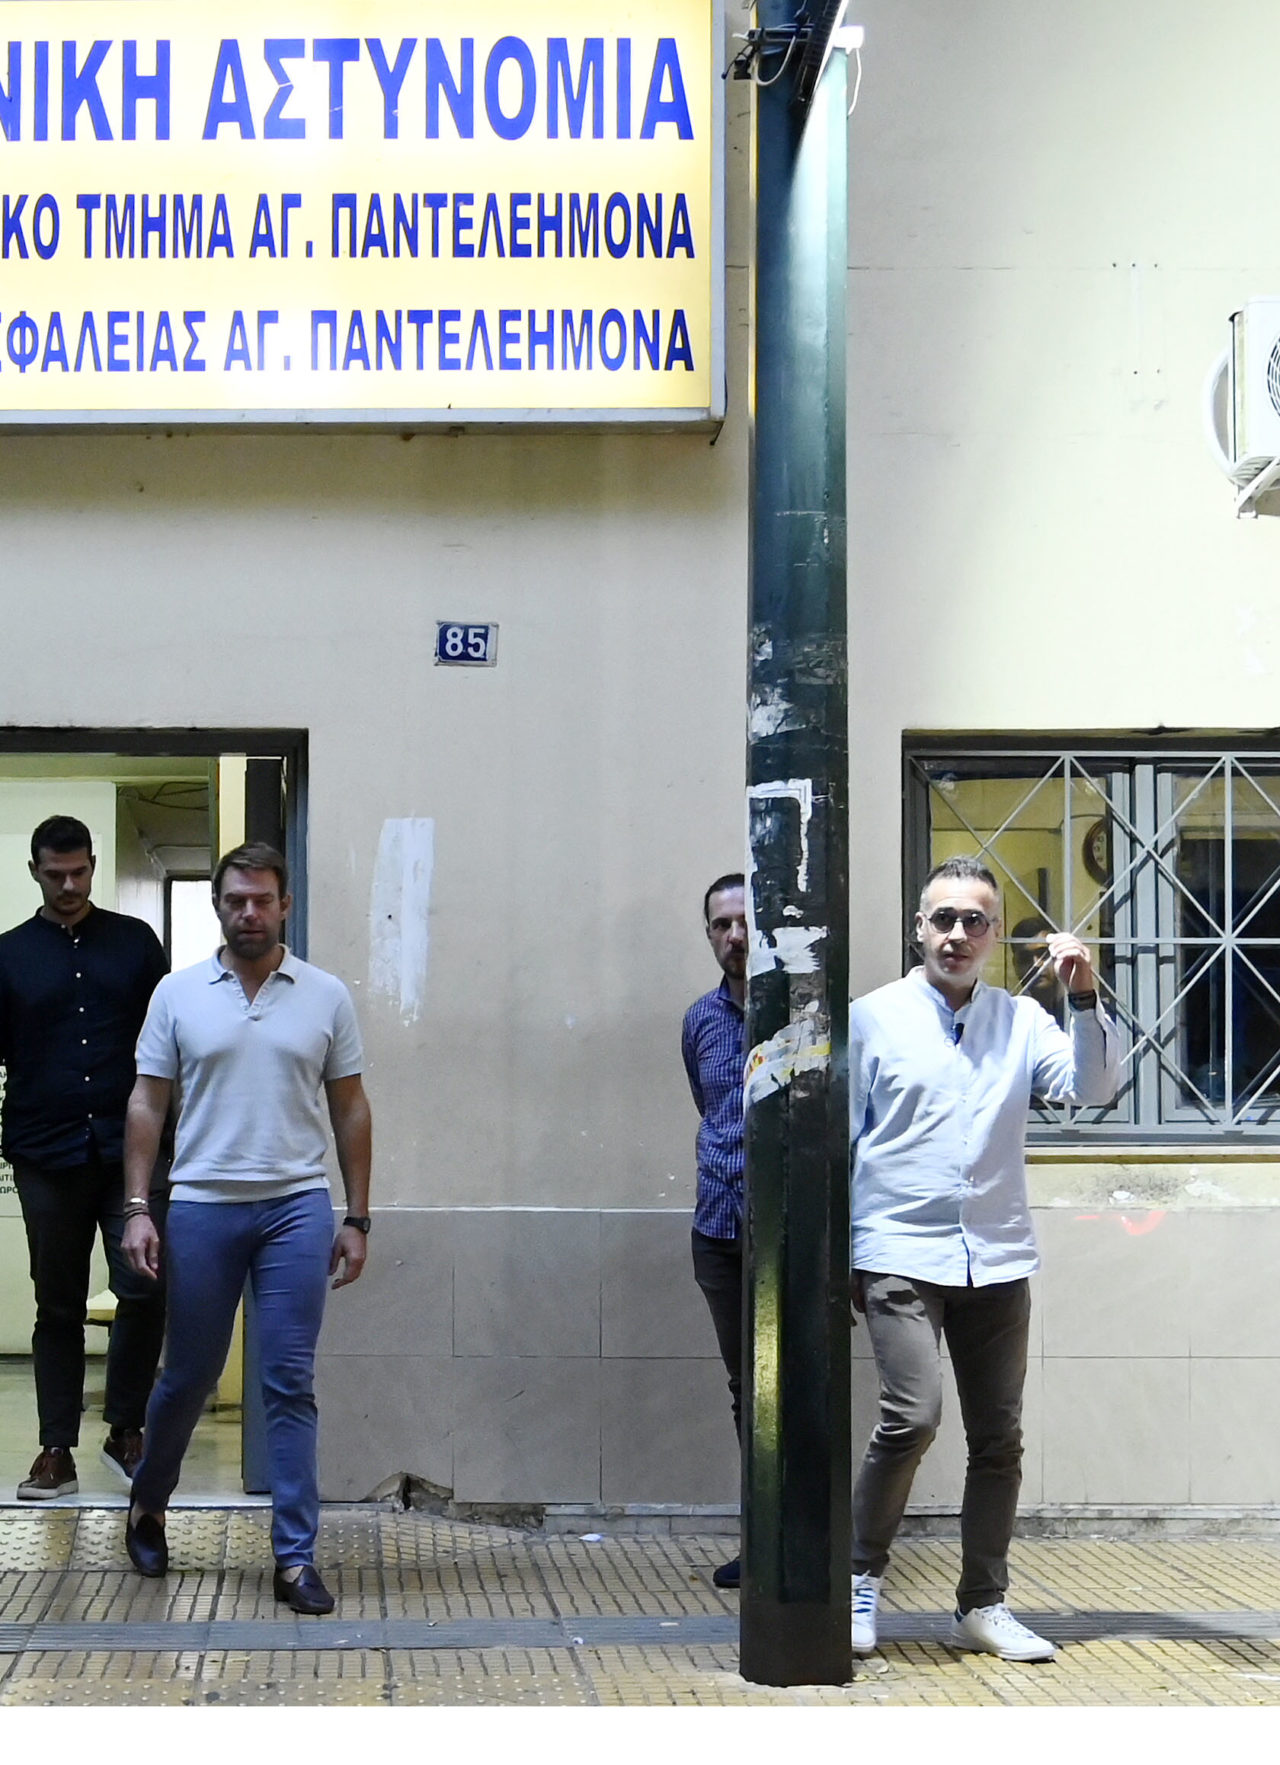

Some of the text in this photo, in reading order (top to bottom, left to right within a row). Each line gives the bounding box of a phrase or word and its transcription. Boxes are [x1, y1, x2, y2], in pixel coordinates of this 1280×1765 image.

[201, 35, 696, 142] ΑΣΤΥΝΟΜΙΑ
[76, 192, 234, 260] ΤΜΗΜΑ
[249, 192, 314, 259] ΑΓ.
[331, 191, 696, 259] ΠΑΝΤΕΛΕΗΜΟΝΑ
[224, 309, 291, 373] ΑΓ.
[310, 307, 696, 373] ΠΑΝΤΕΛΕΗΜΟΝΑ
[445, 626, 486, 658] 85
